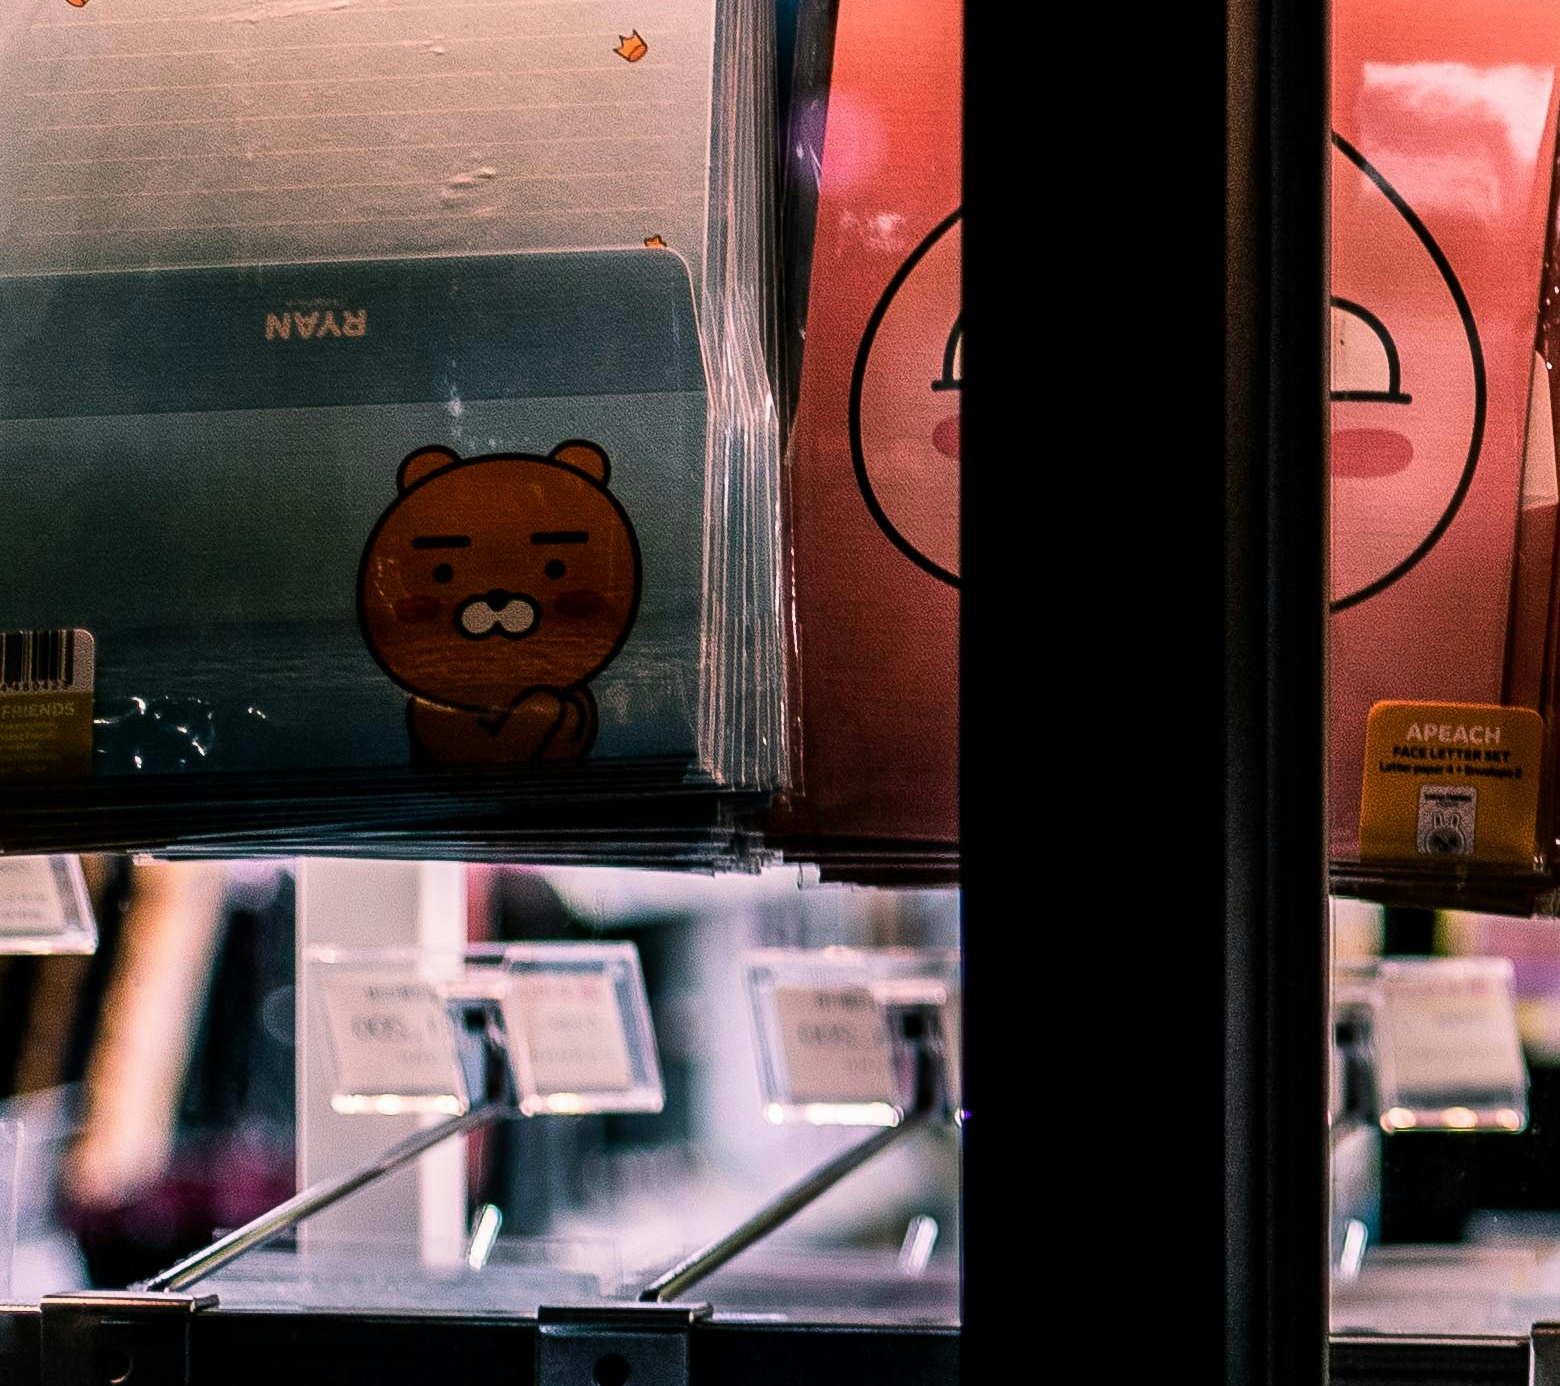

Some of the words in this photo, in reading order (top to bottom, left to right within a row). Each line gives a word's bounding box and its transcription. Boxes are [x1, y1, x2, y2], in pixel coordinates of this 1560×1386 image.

[265, 309, 368, 341] RYAN
[1406, 723, 1502, 745] APEACH
[1393, 745, 1427, 760] FACE
[1430, 746, 1482, 762] LETTER
[1484, 748, 1511, 763] SET
